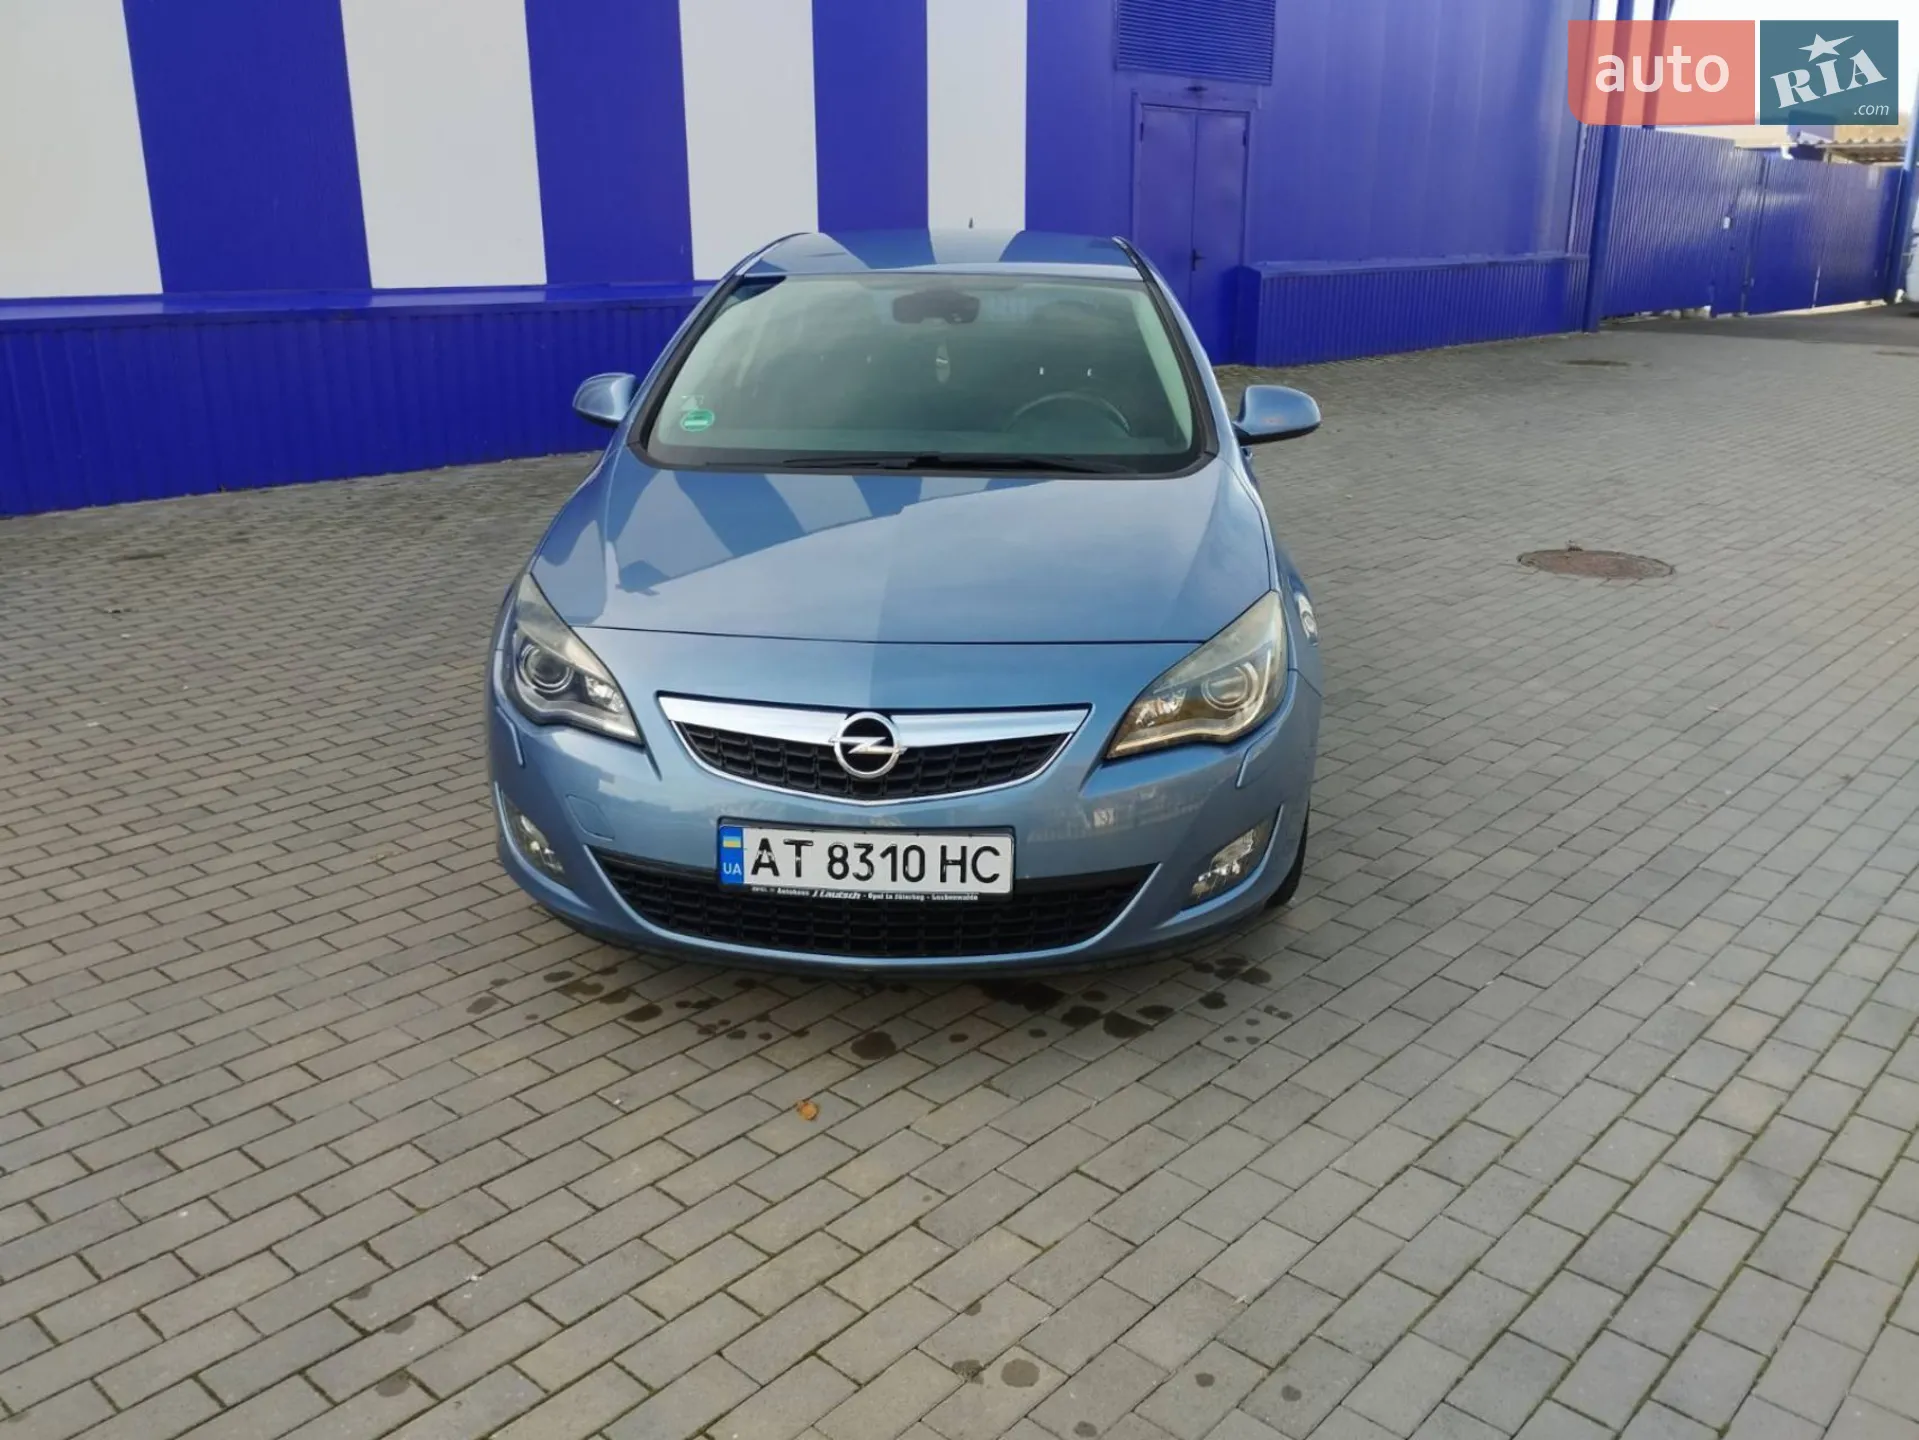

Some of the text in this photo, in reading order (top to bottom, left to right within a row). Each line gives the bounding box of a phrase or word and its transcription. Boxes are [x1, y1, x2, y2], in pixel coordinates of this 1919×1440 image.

[723, 863, 742, 875] UA
[751, 837, 1001, 884] AT 8310 HC
